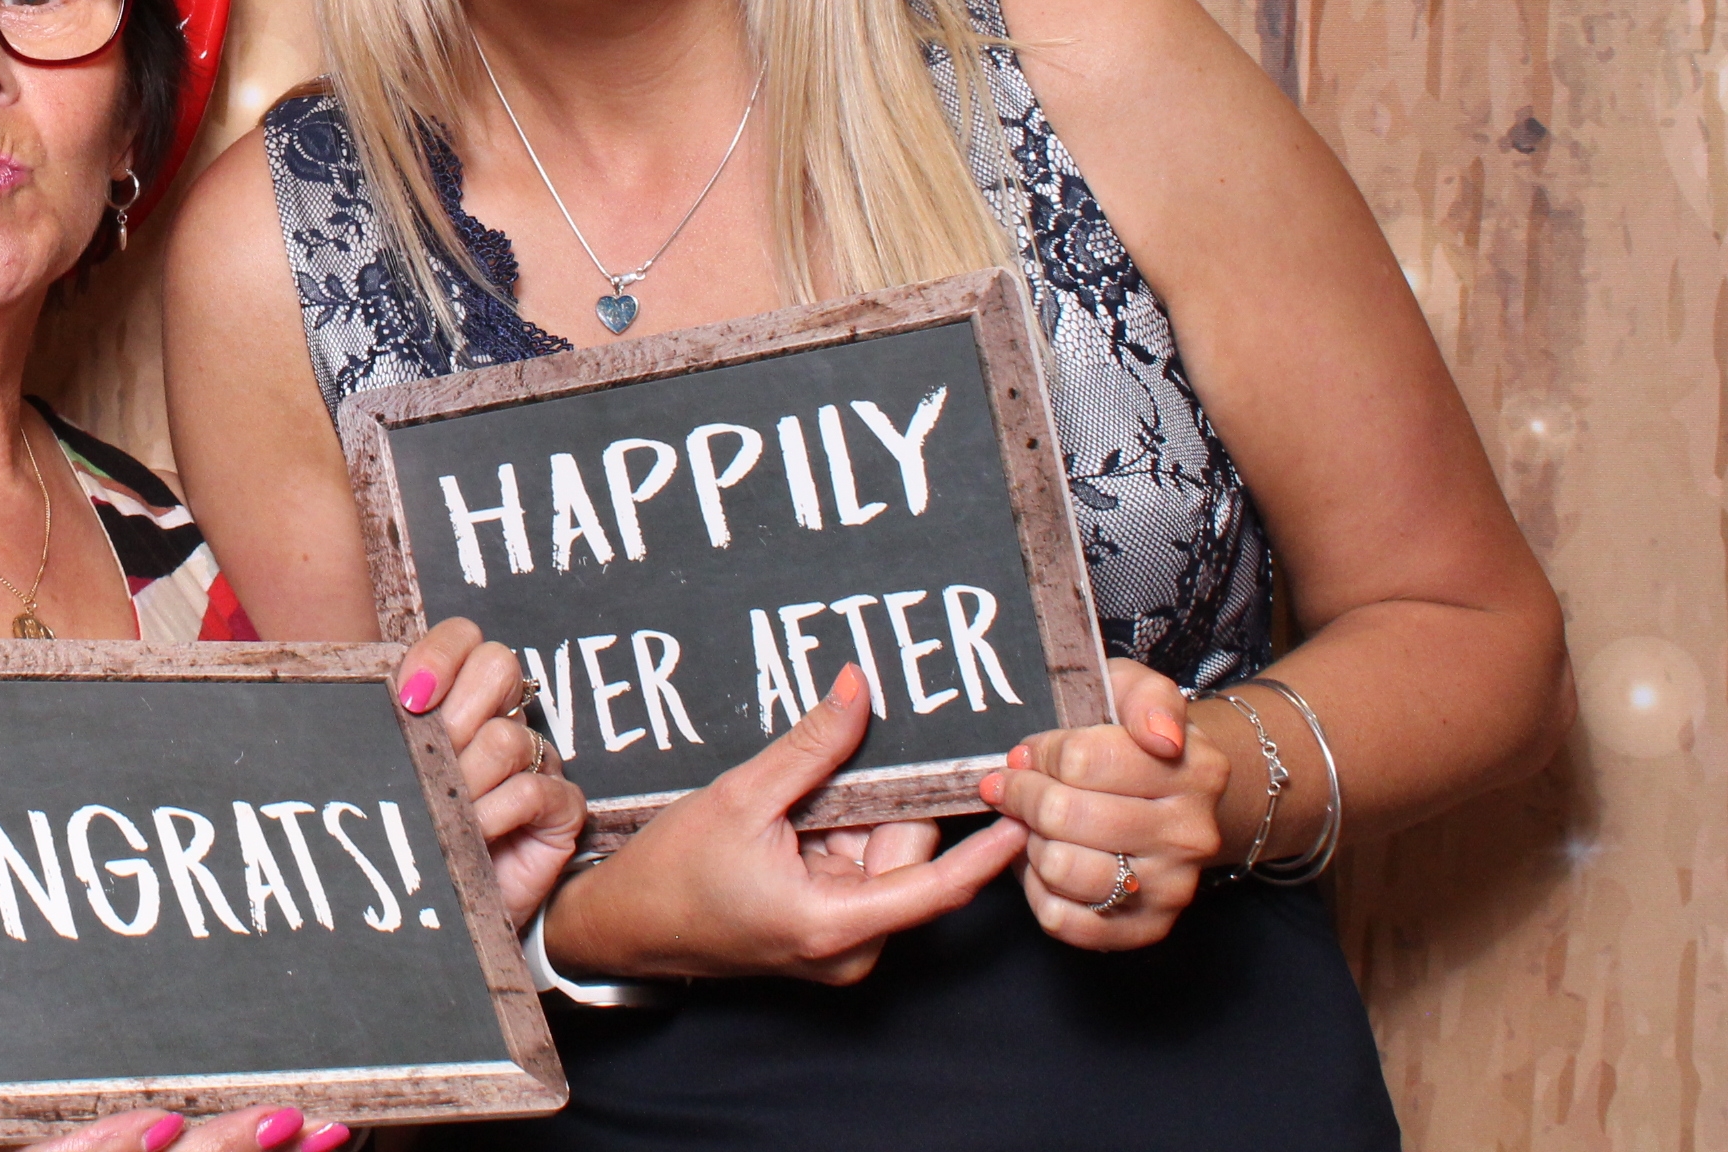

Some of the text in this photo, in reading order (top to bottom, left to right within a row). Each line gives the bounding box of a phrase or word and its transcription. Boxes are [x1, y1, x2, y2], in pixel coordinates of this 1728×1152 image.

[438, 383, 948, 589] HAPPILY
[510, 583, 1024, 762] VER AFTER
